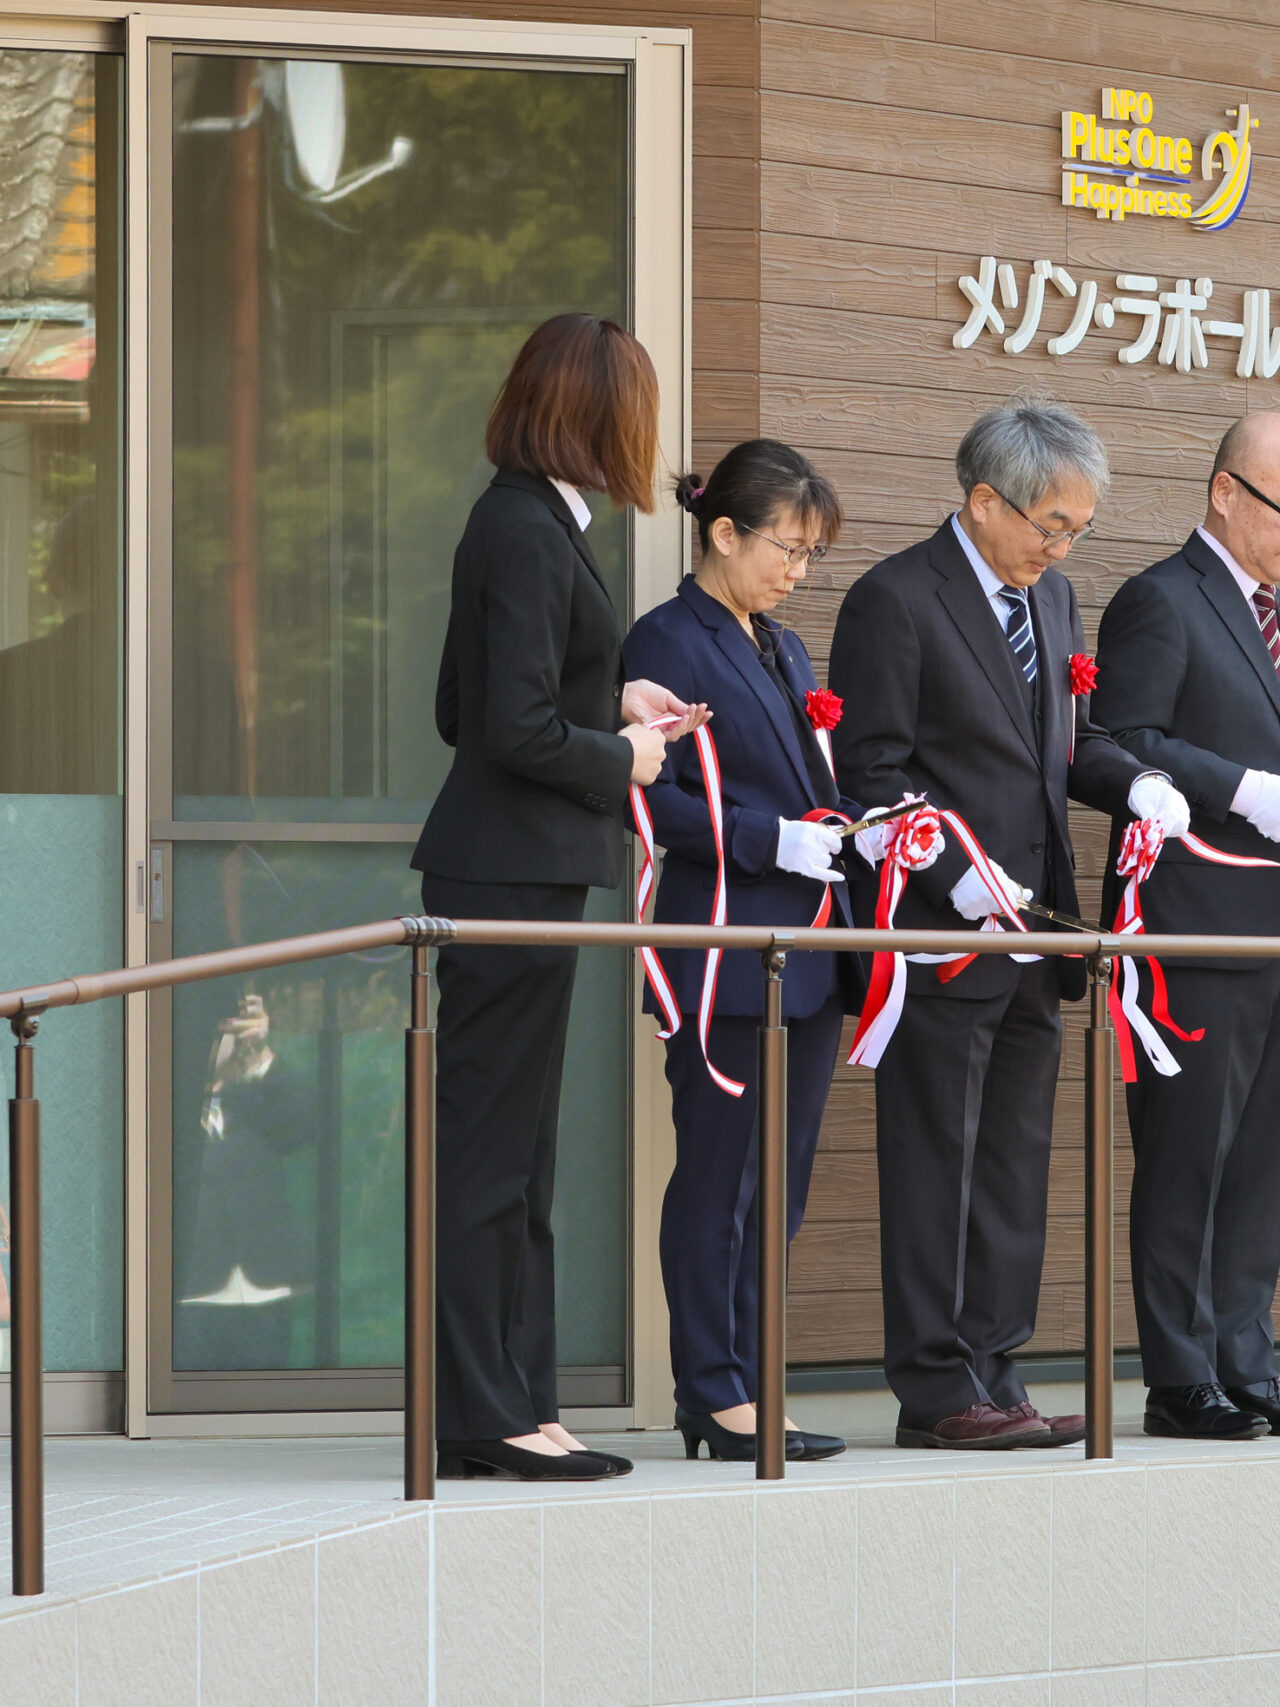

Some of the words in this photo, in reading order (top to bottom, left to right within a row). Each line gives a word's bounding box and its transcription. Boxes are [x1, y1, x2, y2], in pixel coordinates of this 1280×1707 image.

[1103, 88, 1153, 123] NPO
[1062, 112, 1131, 165] Plus
[1131, 128, 1193, 174] One
[1062, 172, 1193, 220] Happiness
